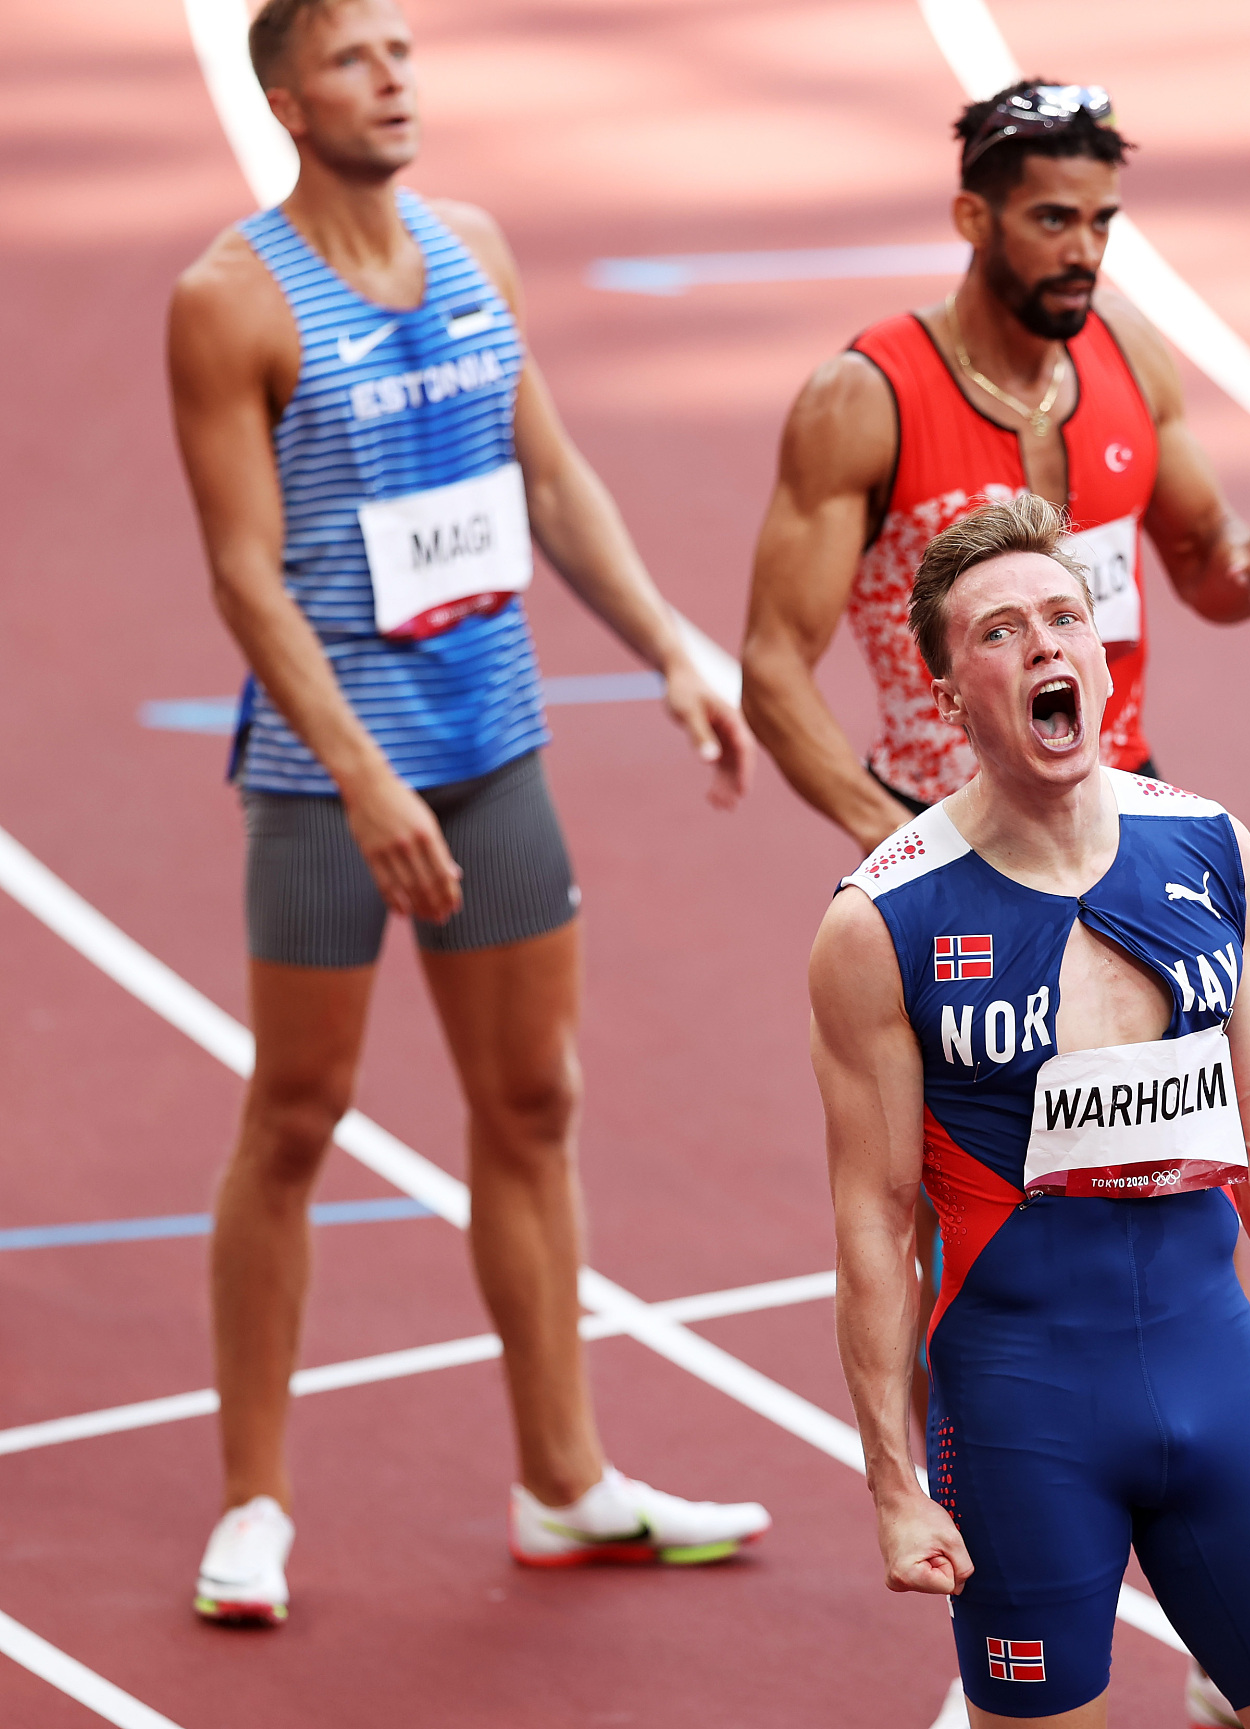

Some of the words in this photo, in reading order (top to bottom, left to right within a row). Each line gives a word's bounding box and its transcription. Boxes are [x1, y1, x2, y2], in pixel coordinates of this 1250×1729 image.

[351, 349, 505, 422] ESTONIA
[1044, 1062, 1228, 1131] WARHOLM
[1091, 1178, 1125, 1189] TOKYO
[1126, 1175, 1149, 1188] 2020
